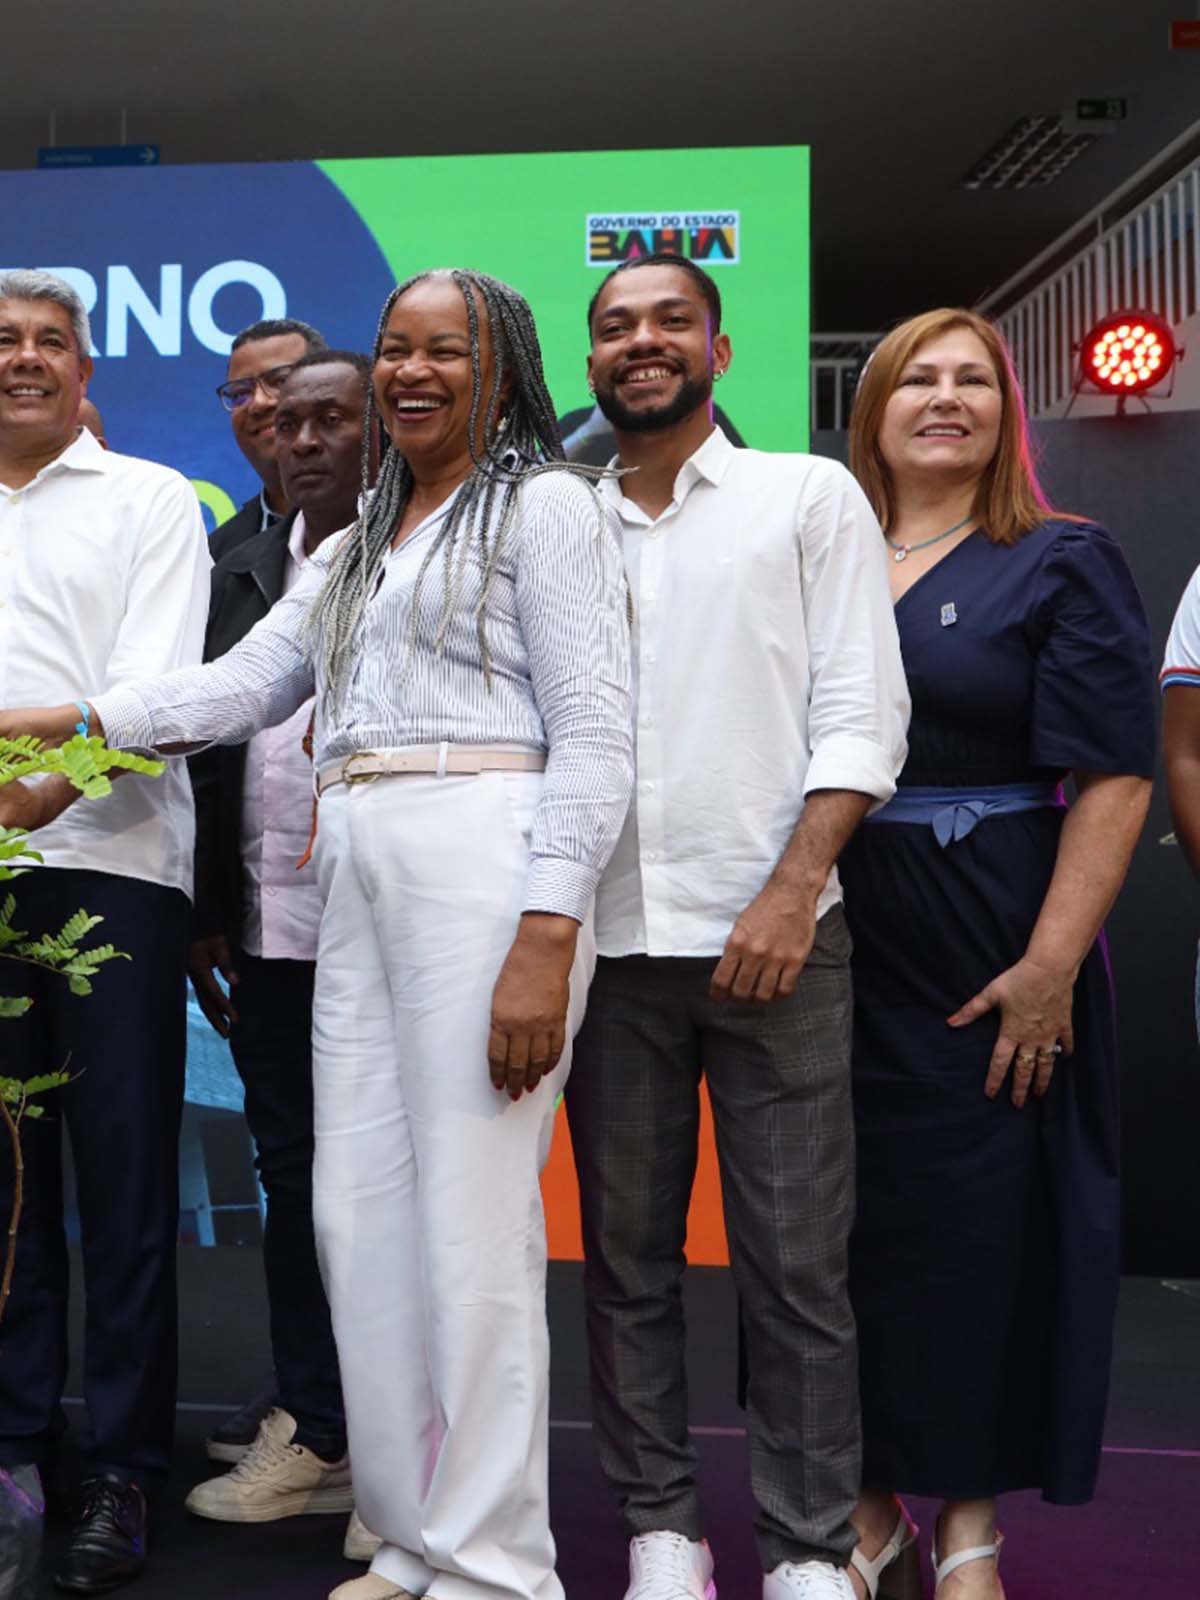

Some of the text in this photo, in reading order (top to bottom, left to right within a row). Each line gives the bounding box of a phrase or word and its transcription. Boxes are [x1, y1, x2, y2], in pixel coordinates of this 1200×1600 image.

[590, 214, 736, 228] GOVERNO DO ESTADO
[590, 227, 735, 261] BAHIA
